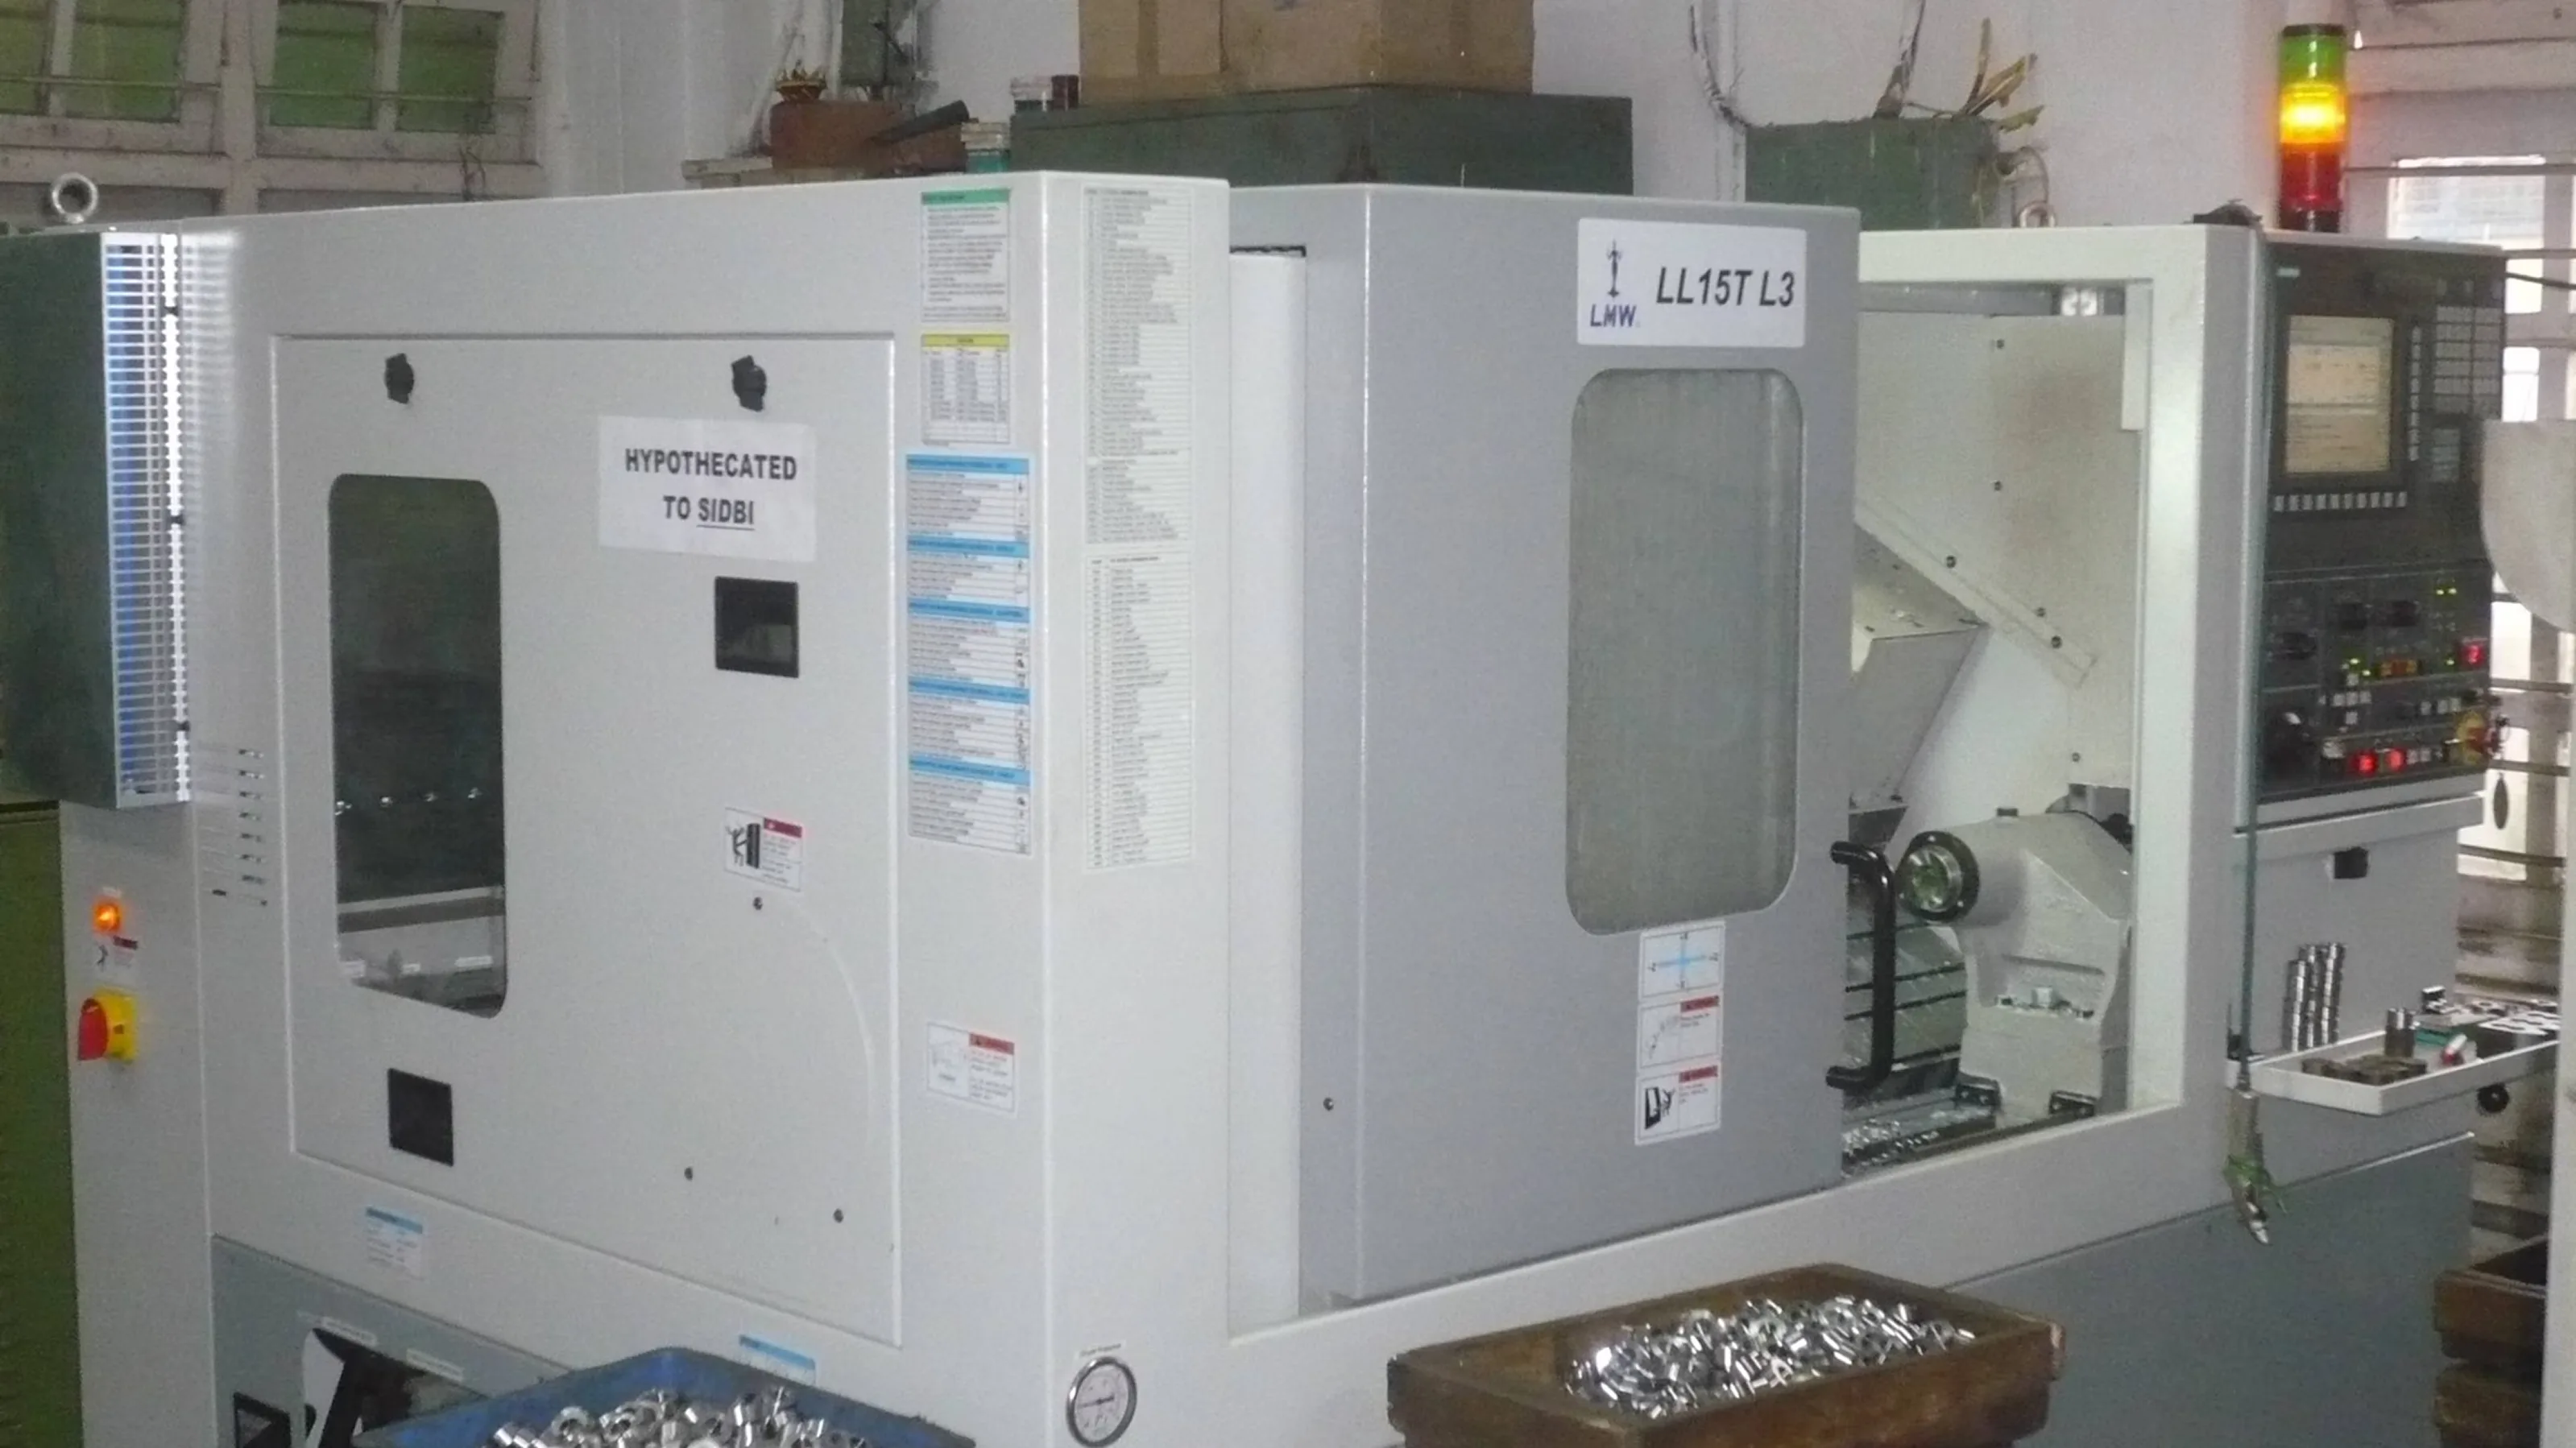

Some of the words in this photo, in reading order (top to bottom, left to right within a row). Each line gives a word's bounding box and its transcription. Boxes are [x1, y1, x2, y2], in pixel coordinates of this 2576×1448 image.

[1656, 267, 1754, 306] LL15T
[1759, 271, 1795, 307] L3
[1590, 304, 1637, 327] LMW
[626, 448, 797, 481] HYPOTHECATED
[663, 494, 691, 520] TO
[698, 497, 755, 525] SIDBI
